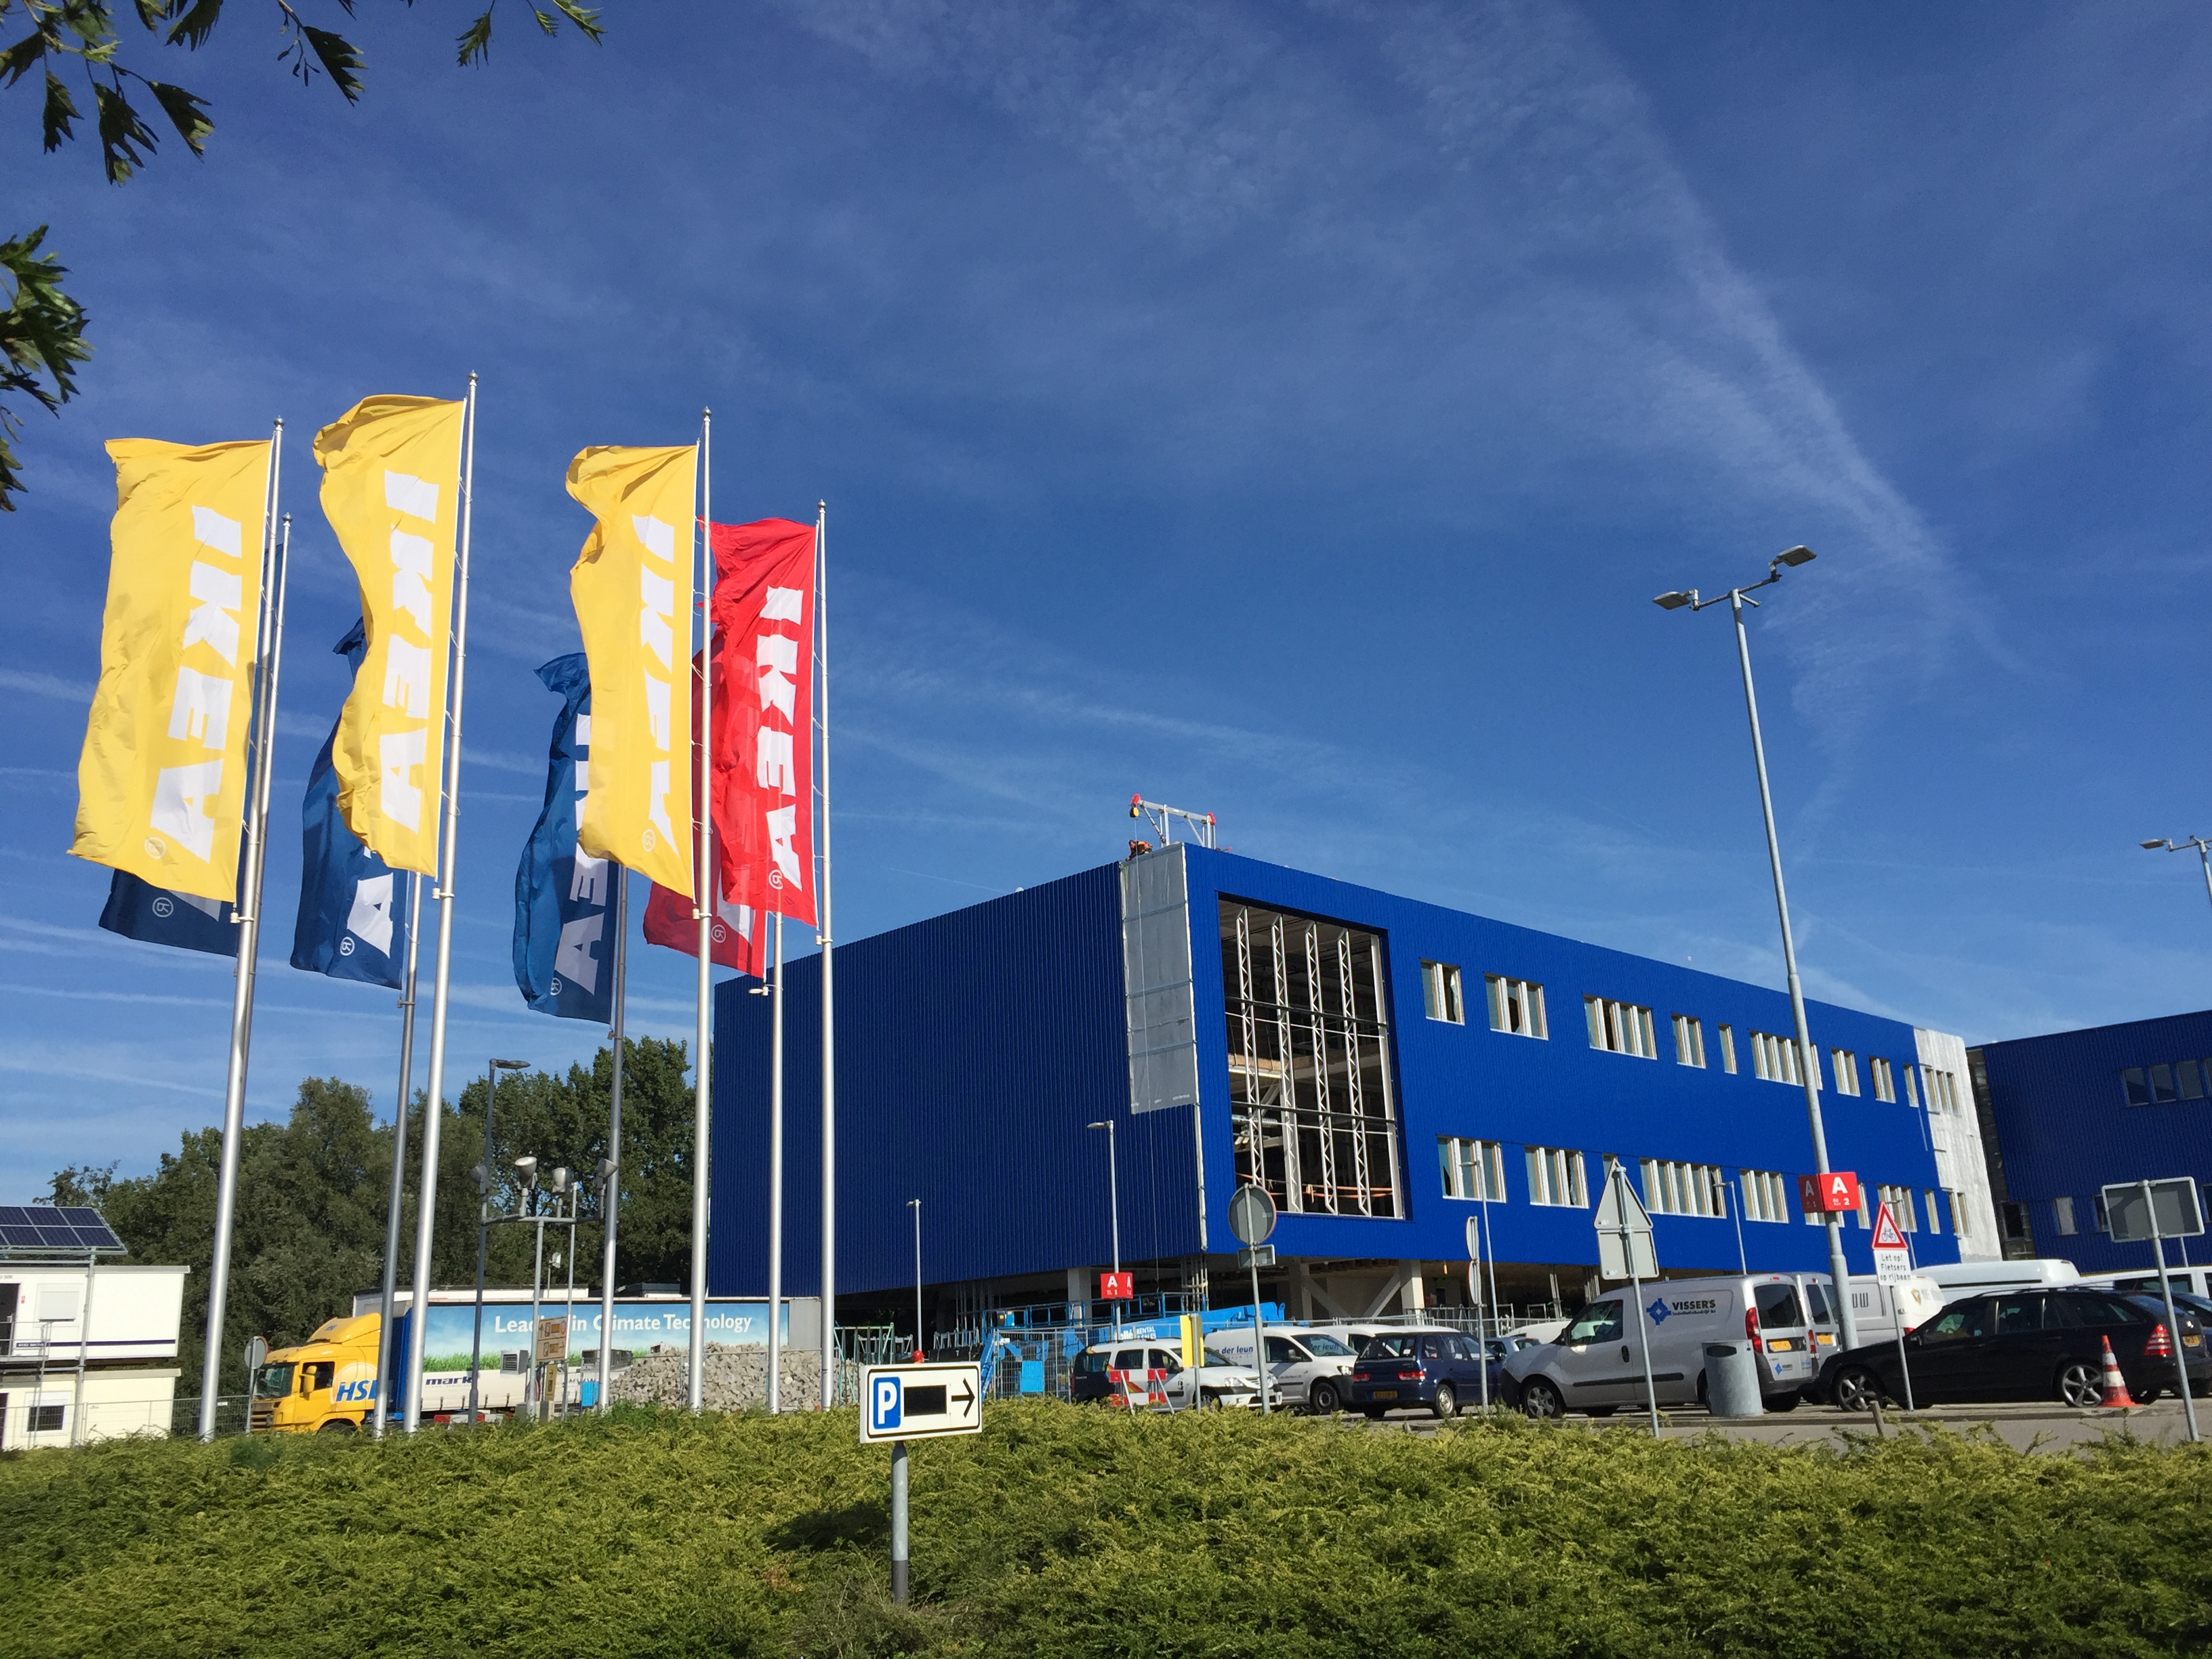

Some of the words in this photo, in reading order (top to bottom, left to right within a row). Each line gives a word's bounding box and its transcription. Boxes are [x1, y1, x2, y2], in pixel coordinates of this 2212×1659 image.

[1805, 1180, 1815, 1197] A
[1832, 1176, 1848, 1195] A
[1843, 1197, 1850, 1206] 2
[1881, 1263, 1906, 1271] Fietsers
[1107, 1275, 1118, 1288] A
[1889, 1273, 1911, 1282] rijbaan
[1672, 1299, 1716, 1311] VISSER'S
[495, 1315, 545, 1333] Lead
[573, 1315, 588, 1331] in
[592, 1313, 661, 1332] Cimate
[663, 1313, 752, 1333] Tecnology
[426, 1376, 473, 1386] mark
[878, 1381, 898, 1425] P
